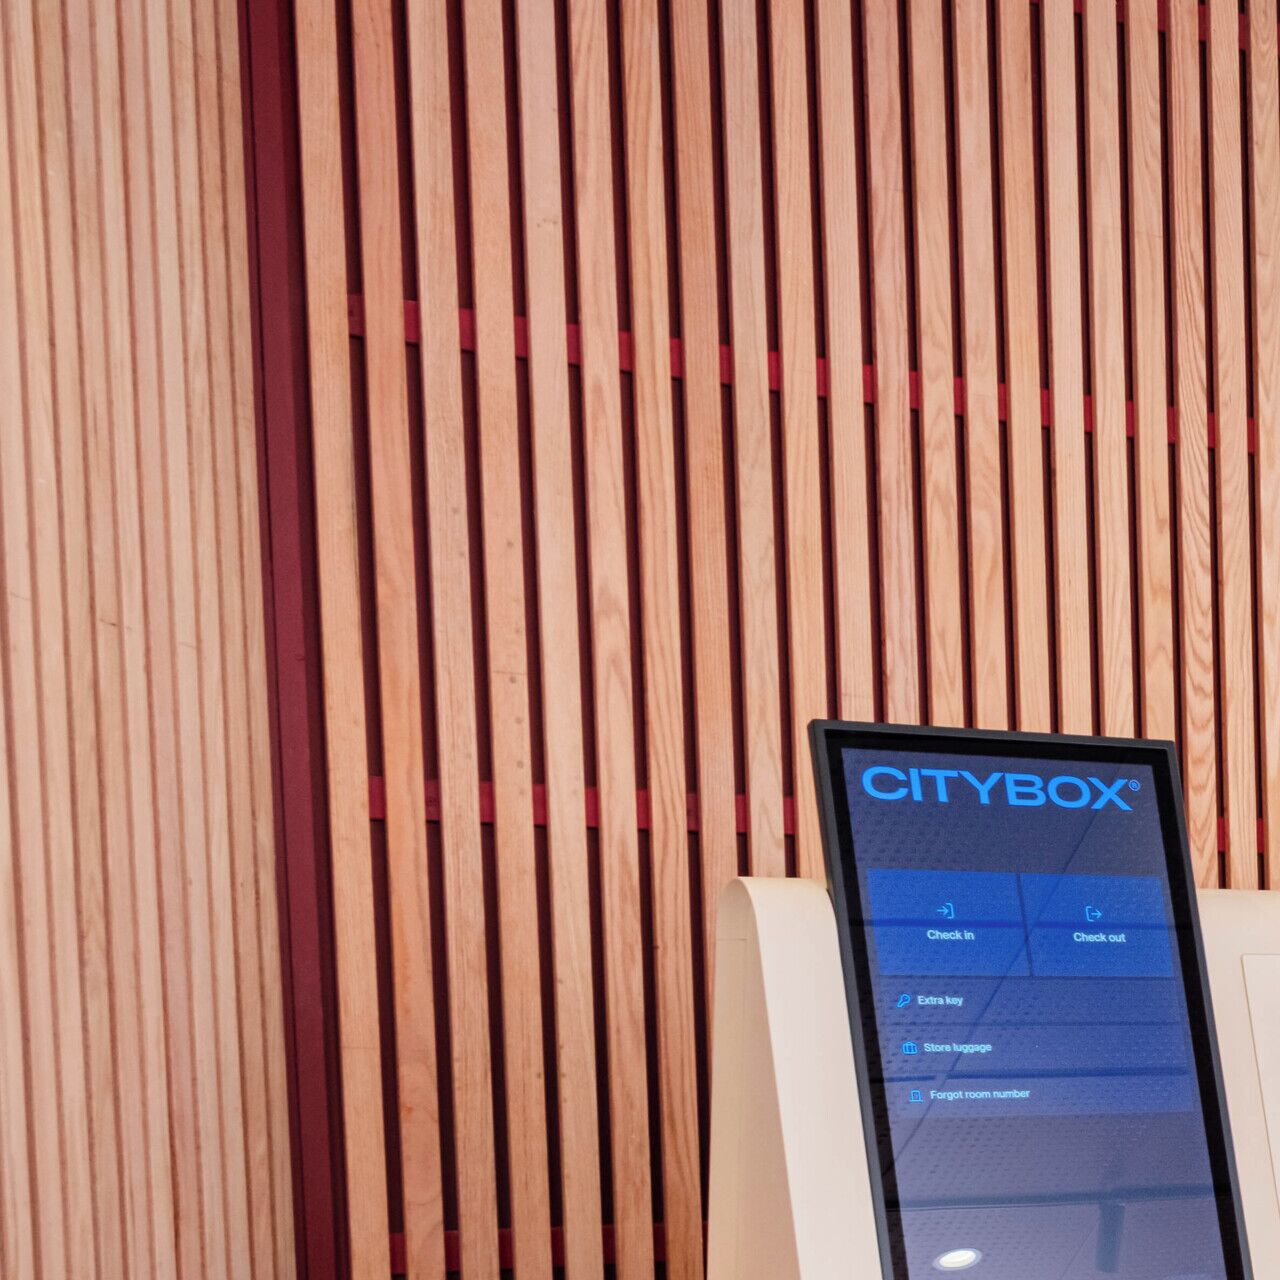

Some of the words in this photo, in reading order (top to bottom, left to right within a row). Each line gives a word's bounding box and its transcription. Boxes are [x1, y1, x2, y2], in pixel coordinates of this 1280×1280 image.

[927, 929, 962, 941] Check
[964, 930, 975, 941] in
[1073, 931, 1108, 943] Check
[1108, 932, 1127, 943] out
[917, 995, 944, 1006] Extra
[946, 995, 963, 1007] key
[923, 1042, 952, 1053] Store
[953, 1042, 992, 1054] luggage
[930, 1090, 963, 1101] Forgot
[965, 1090, 991, 1099] room
[993, 1089, 1031, 1099] number
